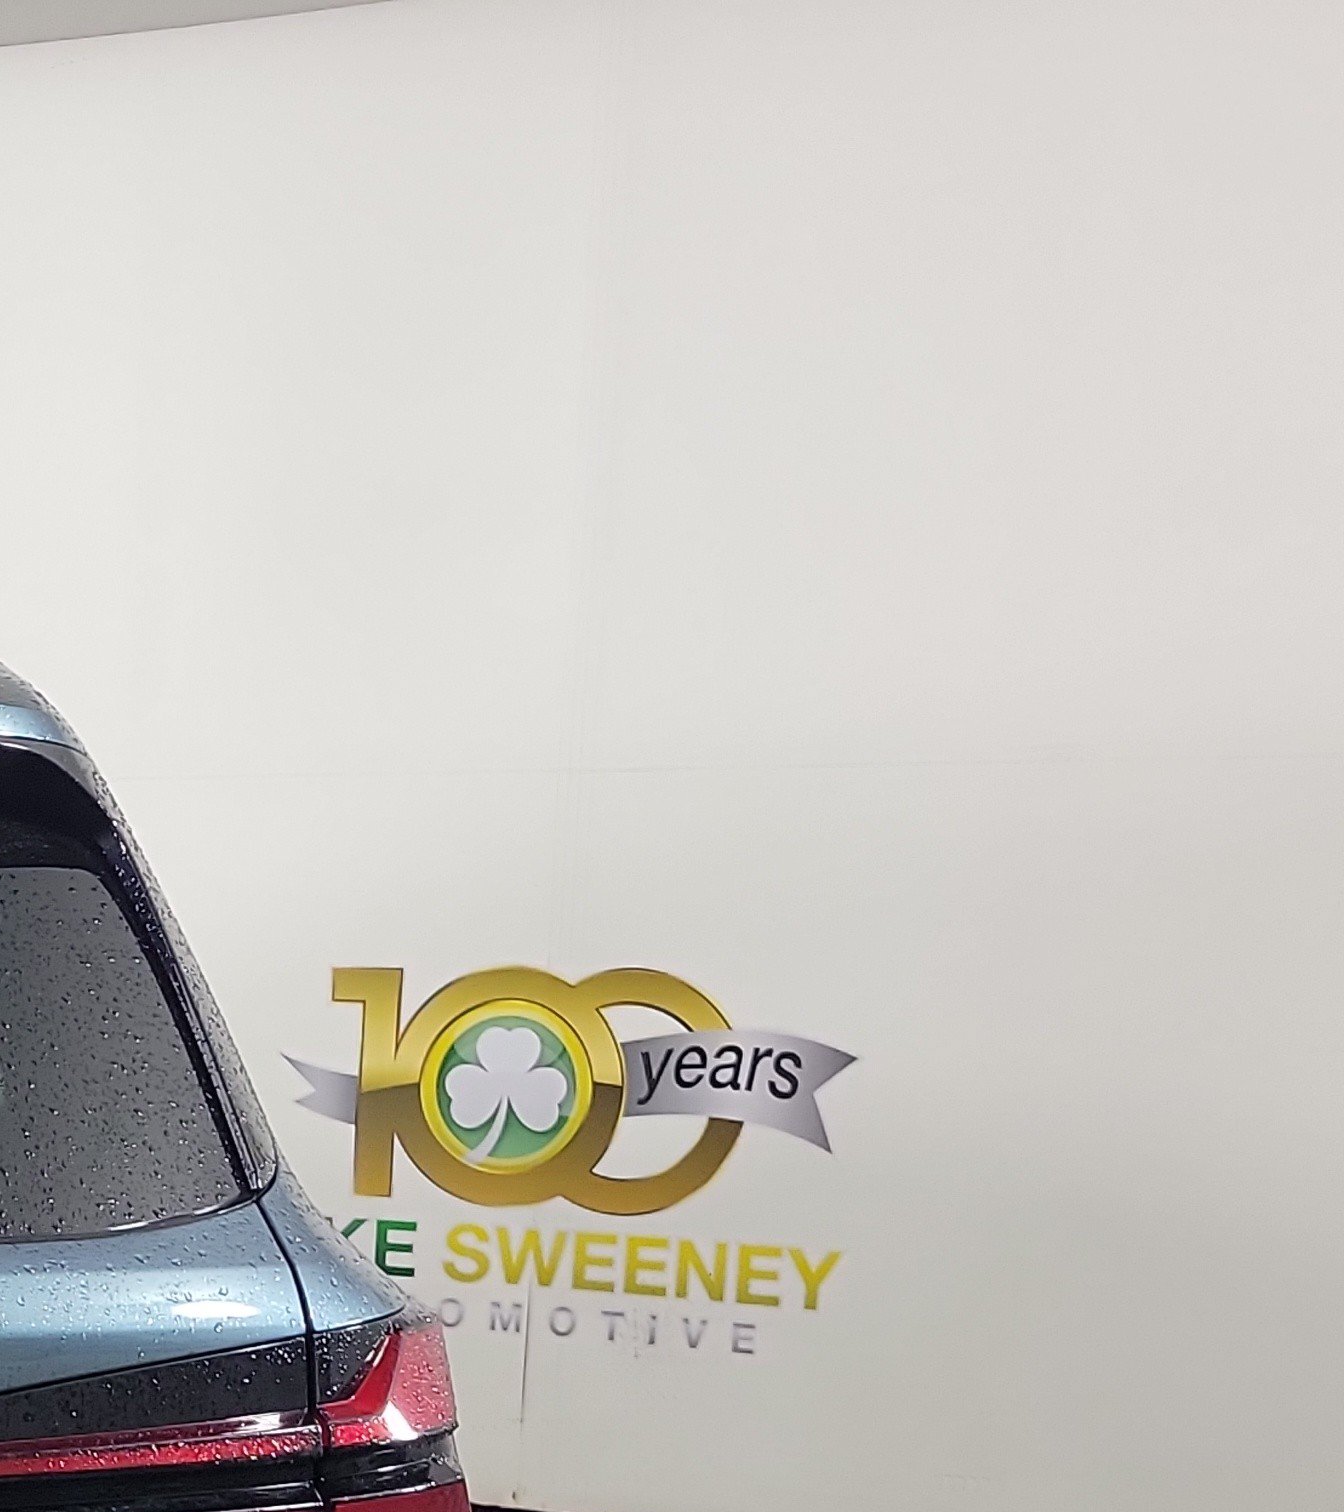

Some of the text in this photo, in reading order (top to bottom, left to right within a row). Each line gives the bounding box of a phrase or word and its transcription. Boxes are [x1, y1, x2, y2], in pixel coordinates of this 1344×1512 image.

[331, 965, 803, 1216] 100 years
[443, 1222, 843, 1311] SWEENEY
